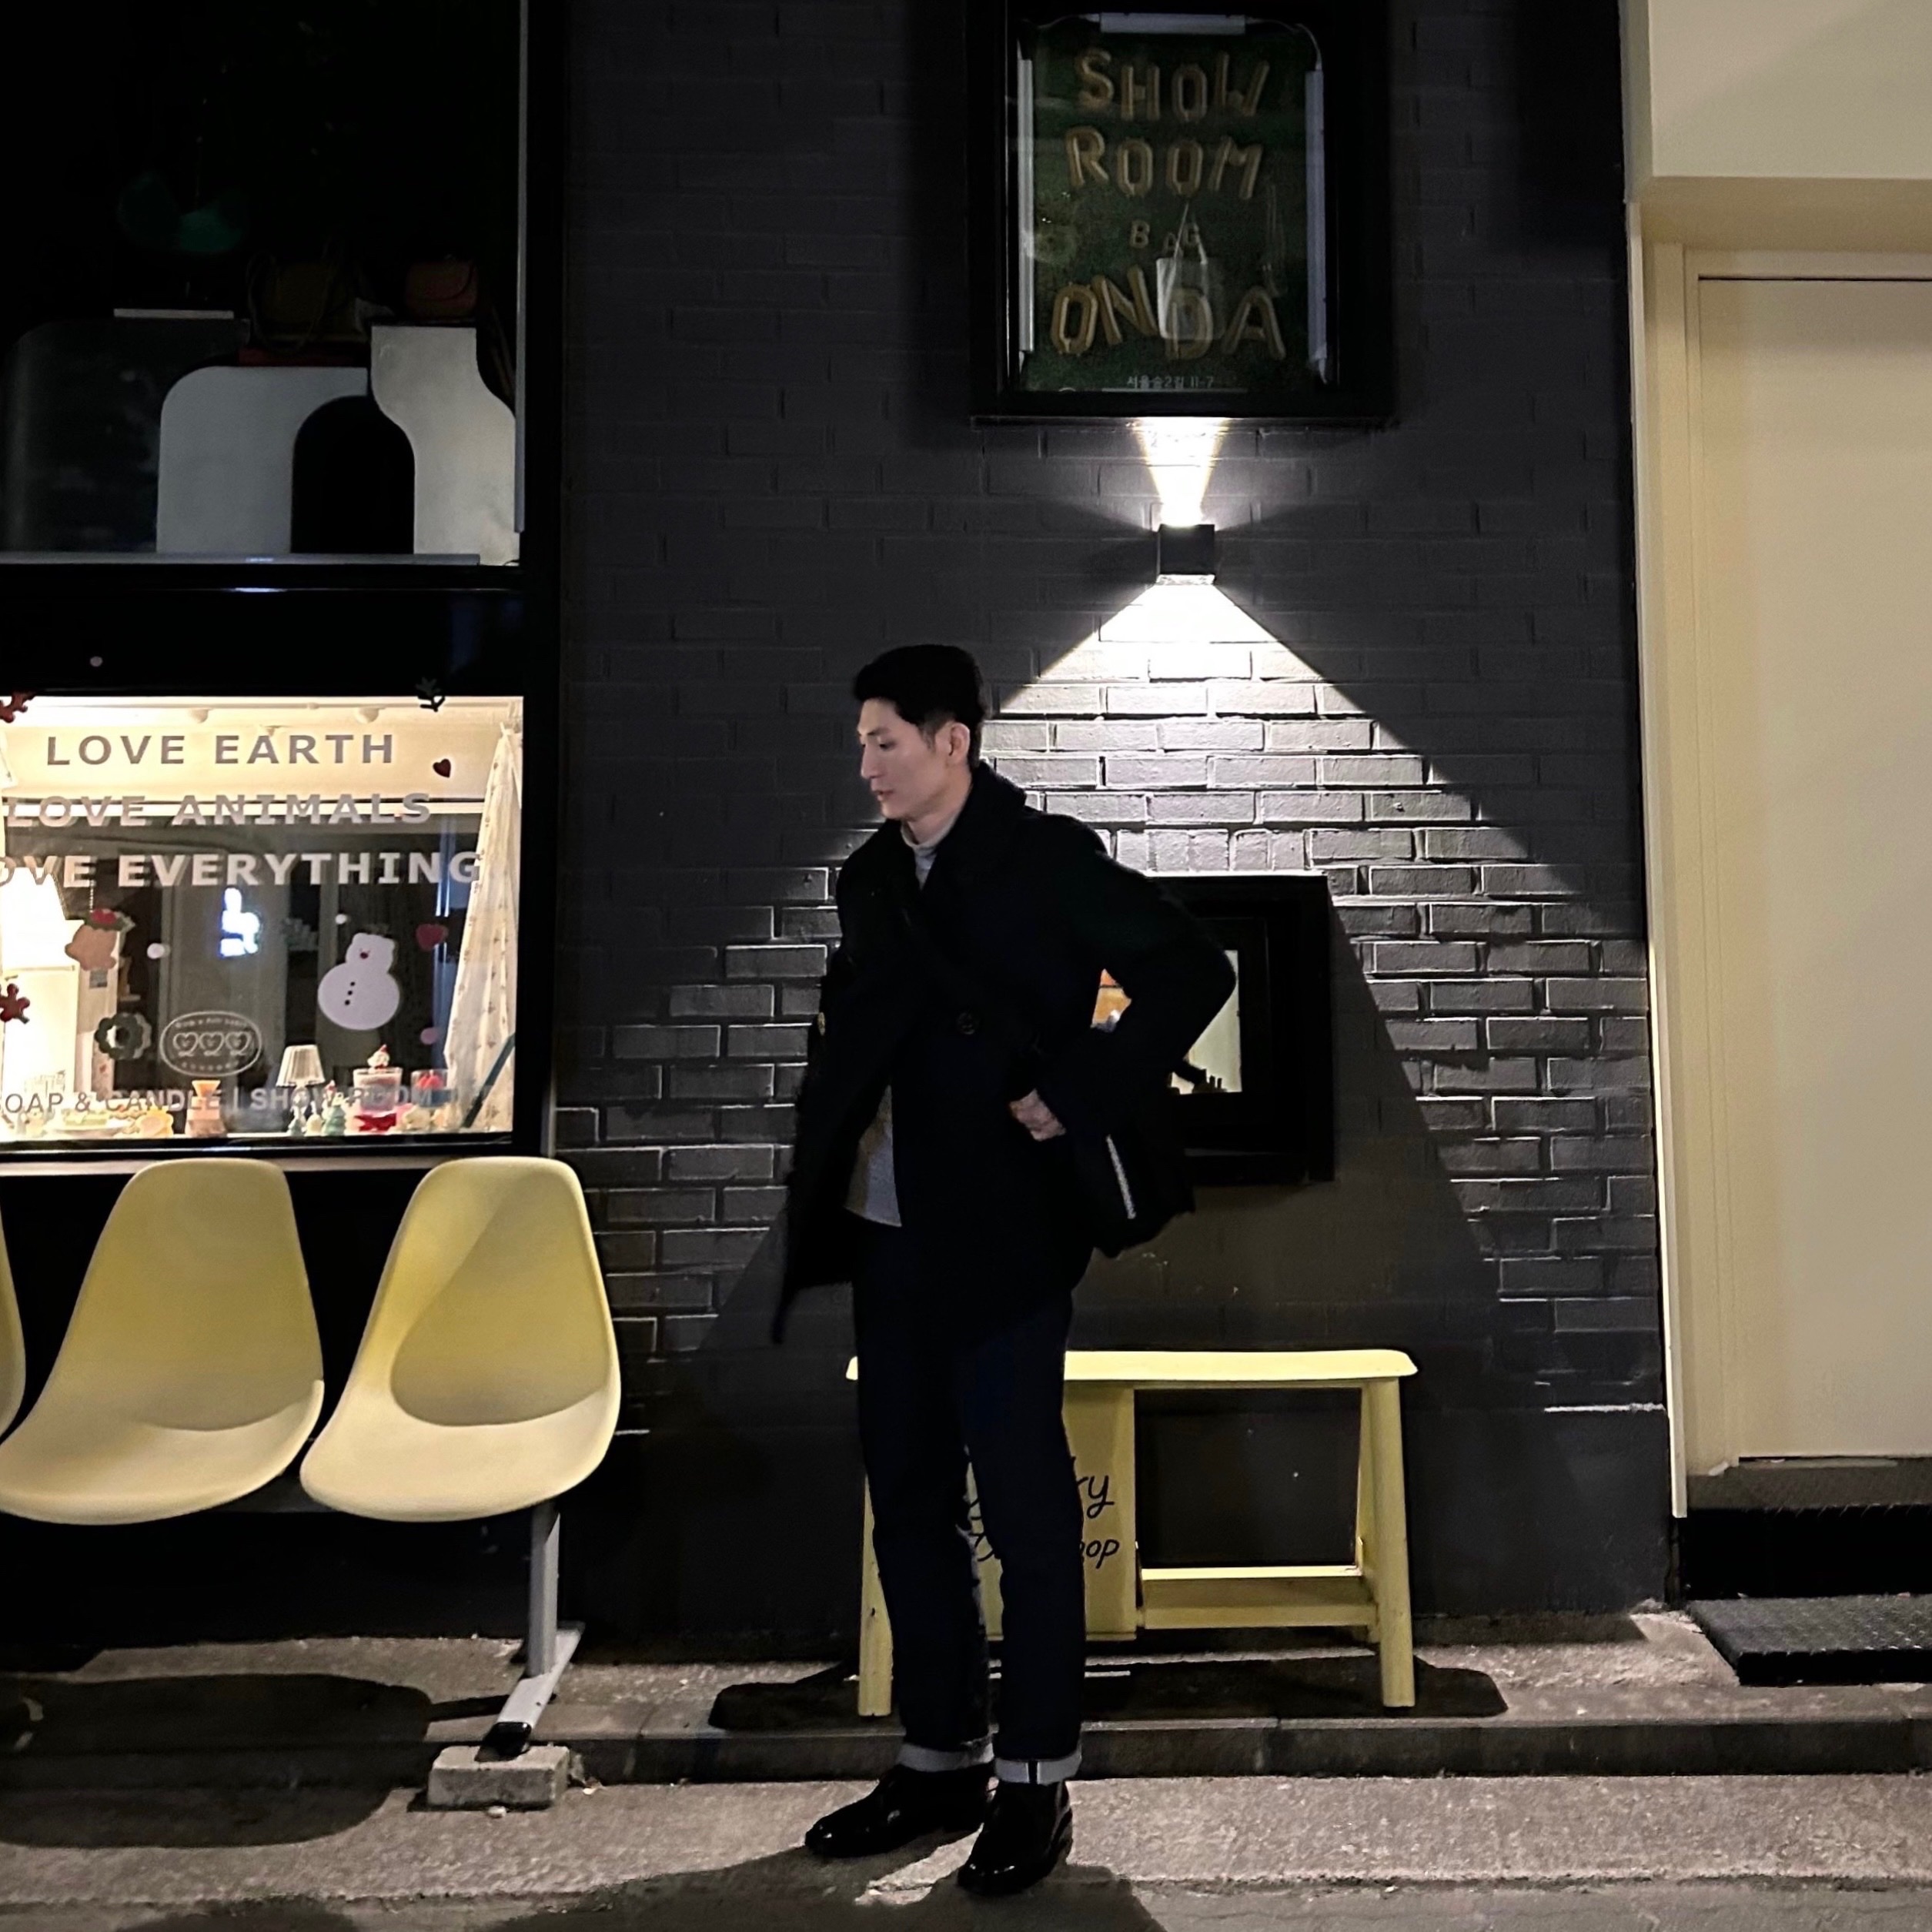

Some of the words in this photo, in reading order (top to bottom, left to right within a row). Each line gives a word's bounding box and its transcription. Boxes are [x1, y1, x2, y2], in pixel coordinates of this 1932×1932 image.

[1079, 48, 1269, 122] SHOW
[1065, 125, 1264, 199] ROOM
[1050, 264, 1286, 360] ONDA
[46, 735, 186, 766] LOVE
[215, 734, 393, 764] EARTH
[7, 796, 146, 827] LOVE
[171, 794, 431, 825] ANIMALS
[118, 851, 480, 887] EVERYTHING
[75, 1092, 92, 1111] &
[105, 1089, 221, 1112] CANDLE
